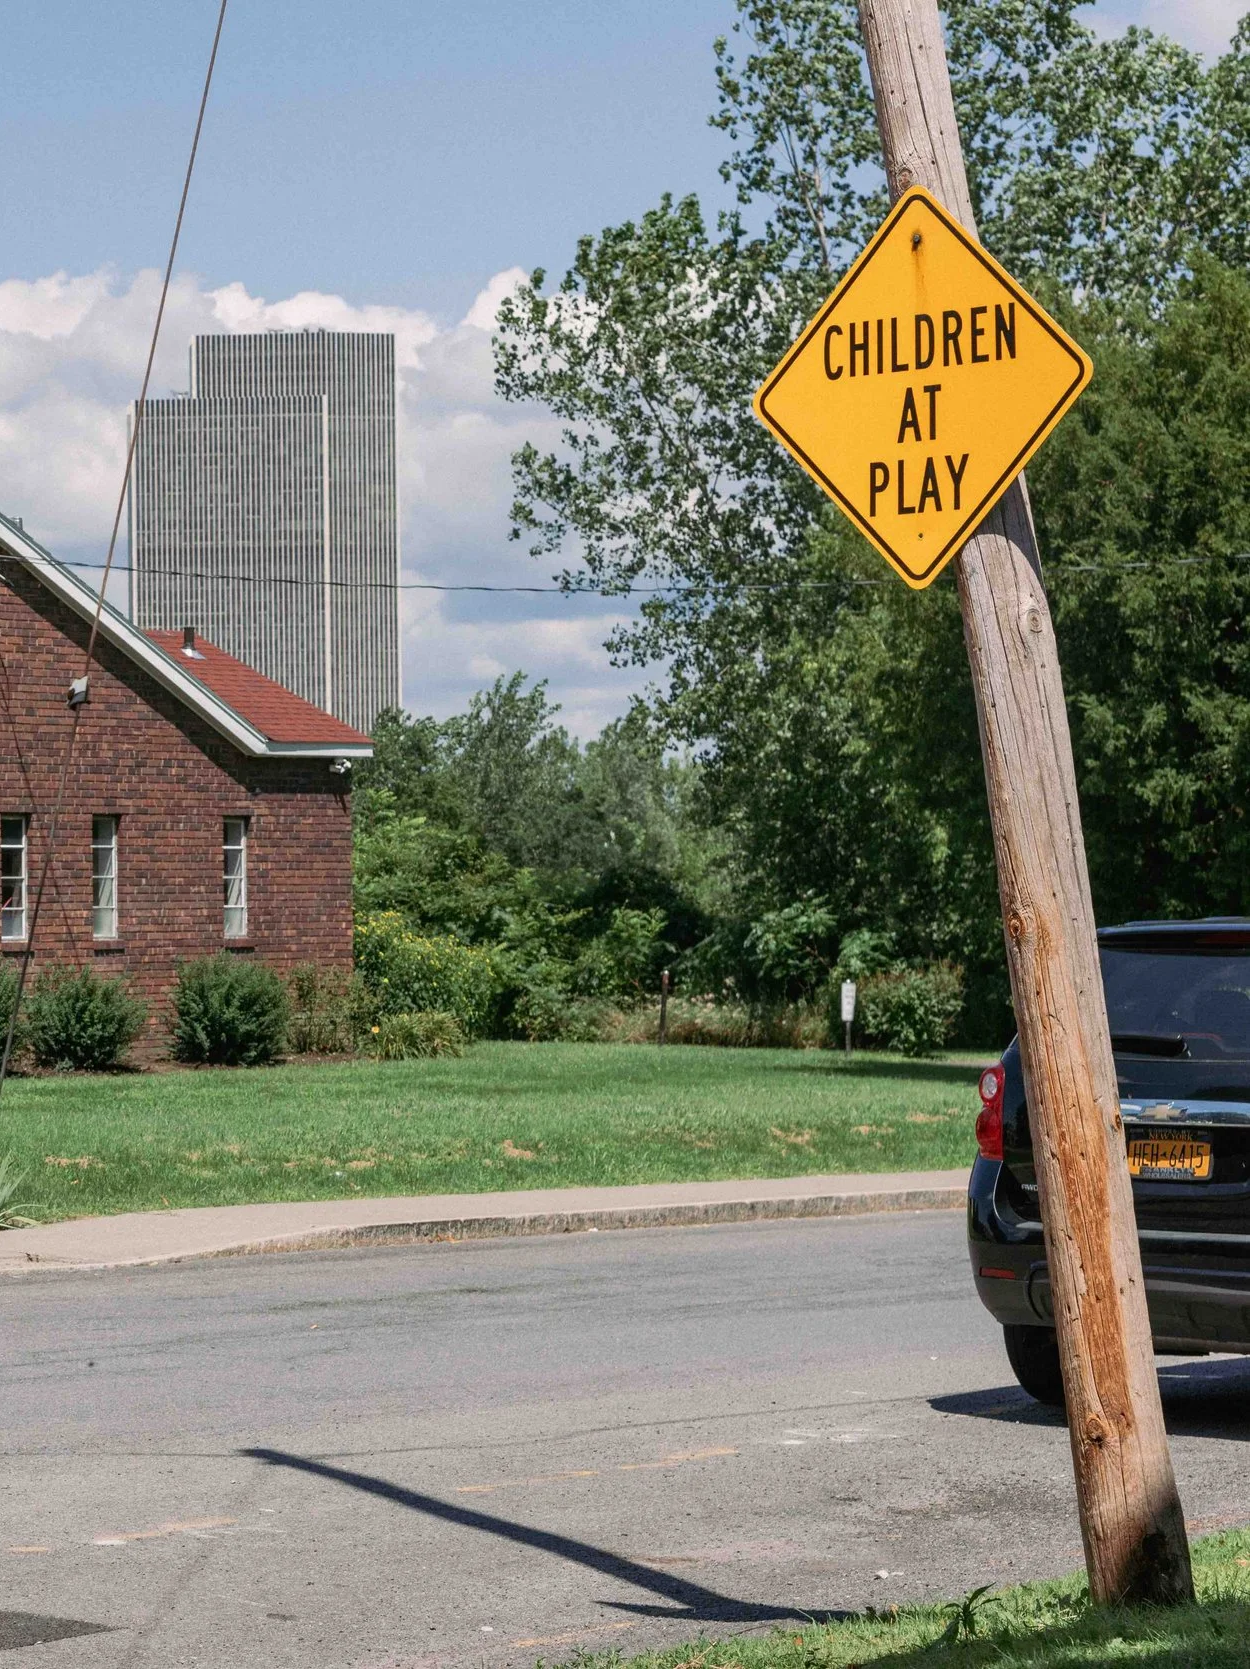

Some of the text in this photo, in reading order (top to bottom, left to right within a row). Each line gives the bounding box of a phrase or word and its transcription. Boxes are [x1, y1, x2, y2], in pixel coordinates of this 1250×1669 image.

[823, 302, 1017, 381] CHILDREN
[897, 384, 942, 444] AT
[869, 453, 970, 518] PLAY
[1148, 1131, 1169, 1140] NEW
[1170, 1131, 1194, 1141] YORK
[1169, 1144, 1204, 1168] 6415
